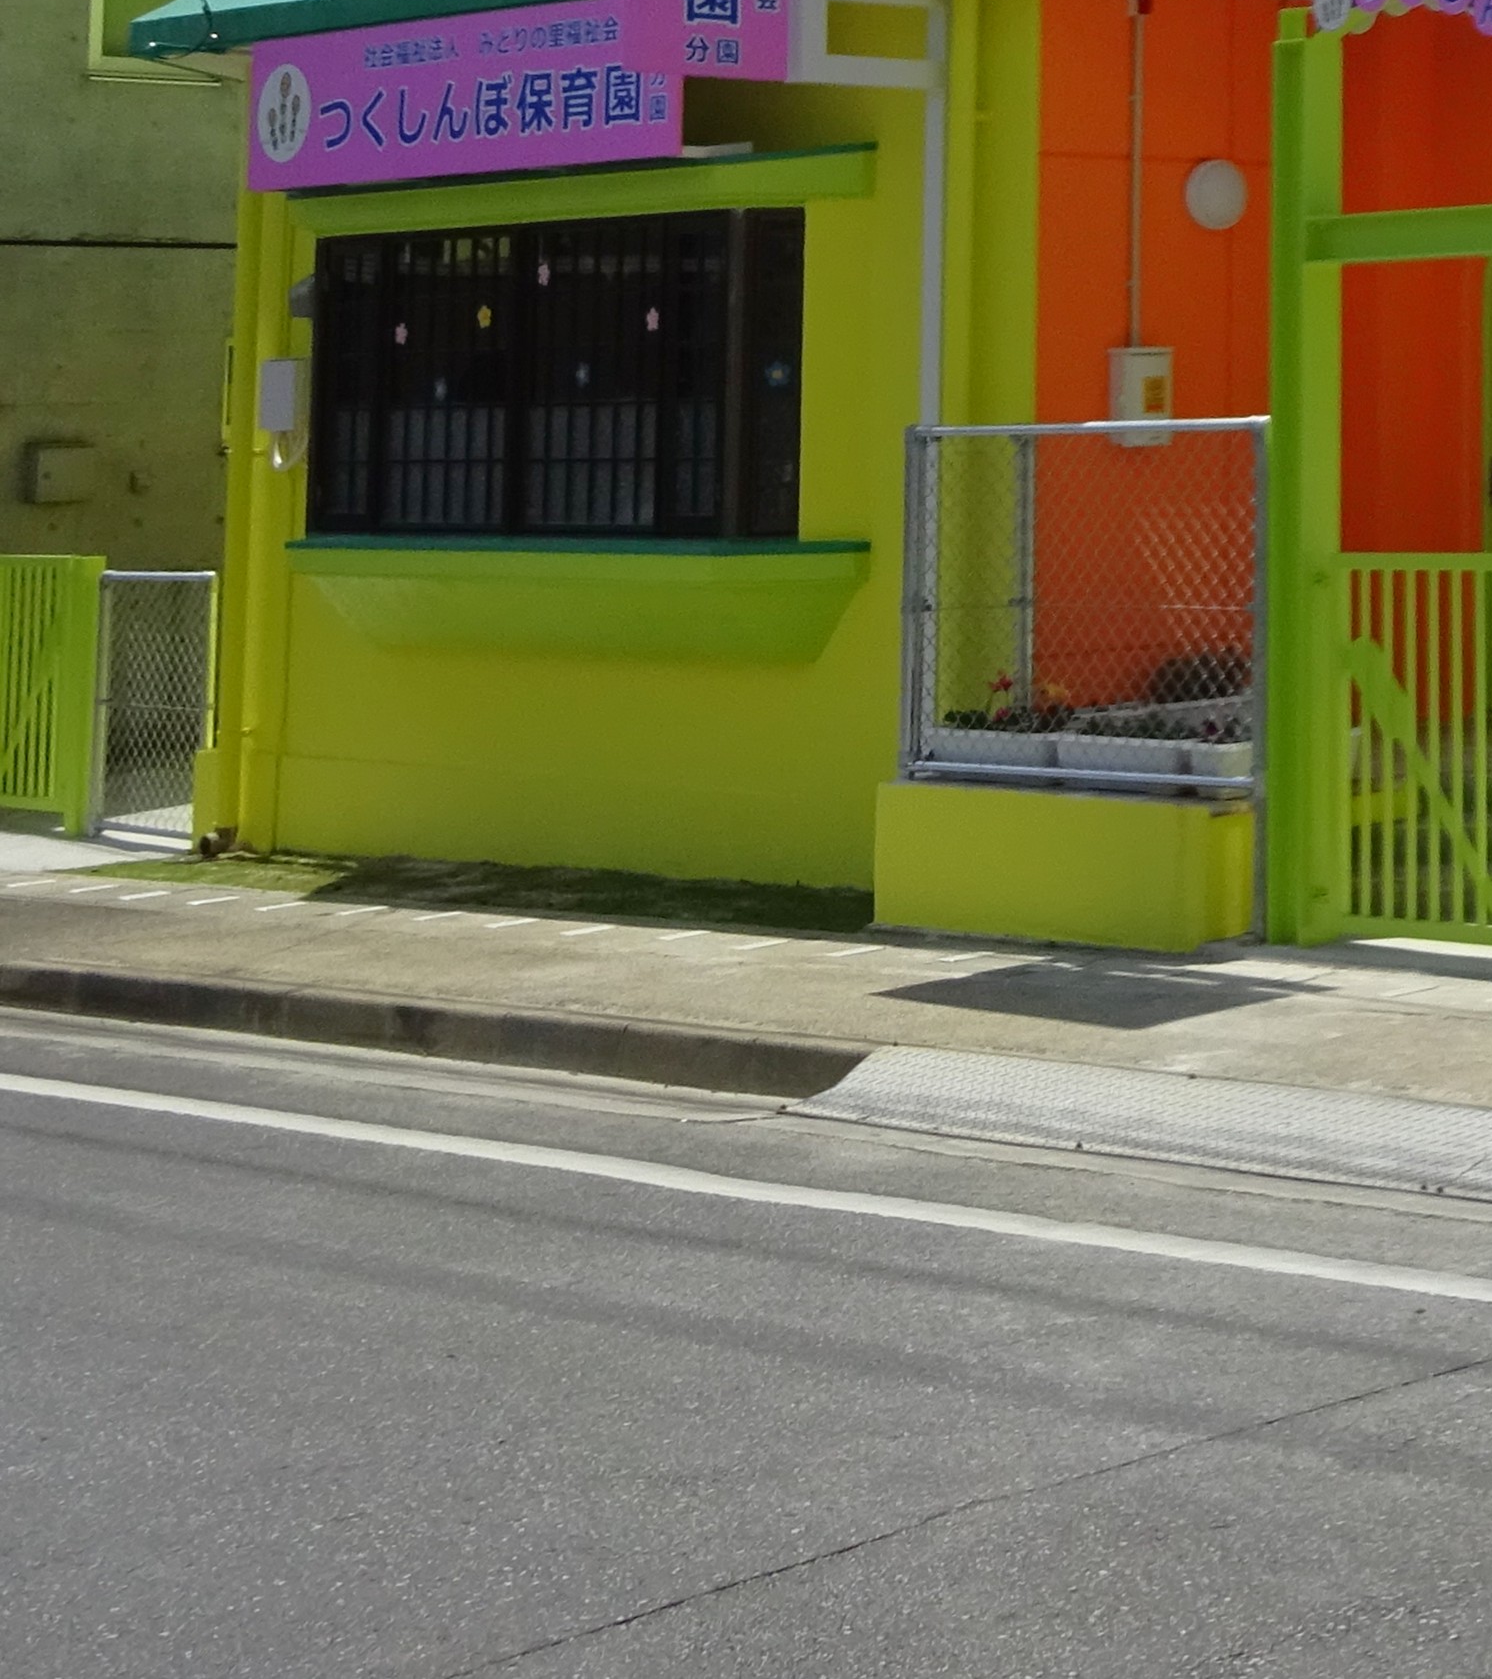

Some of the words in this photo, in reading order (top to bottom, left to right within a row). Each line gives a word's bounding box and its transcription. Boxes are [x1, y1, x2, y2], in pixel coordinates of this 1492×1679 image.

[364, 37, 460, 68] 社会福祉法人
[686, 36, 740, 64] 分園
[318, 64, 642, 149] つくしんぼ保育園
